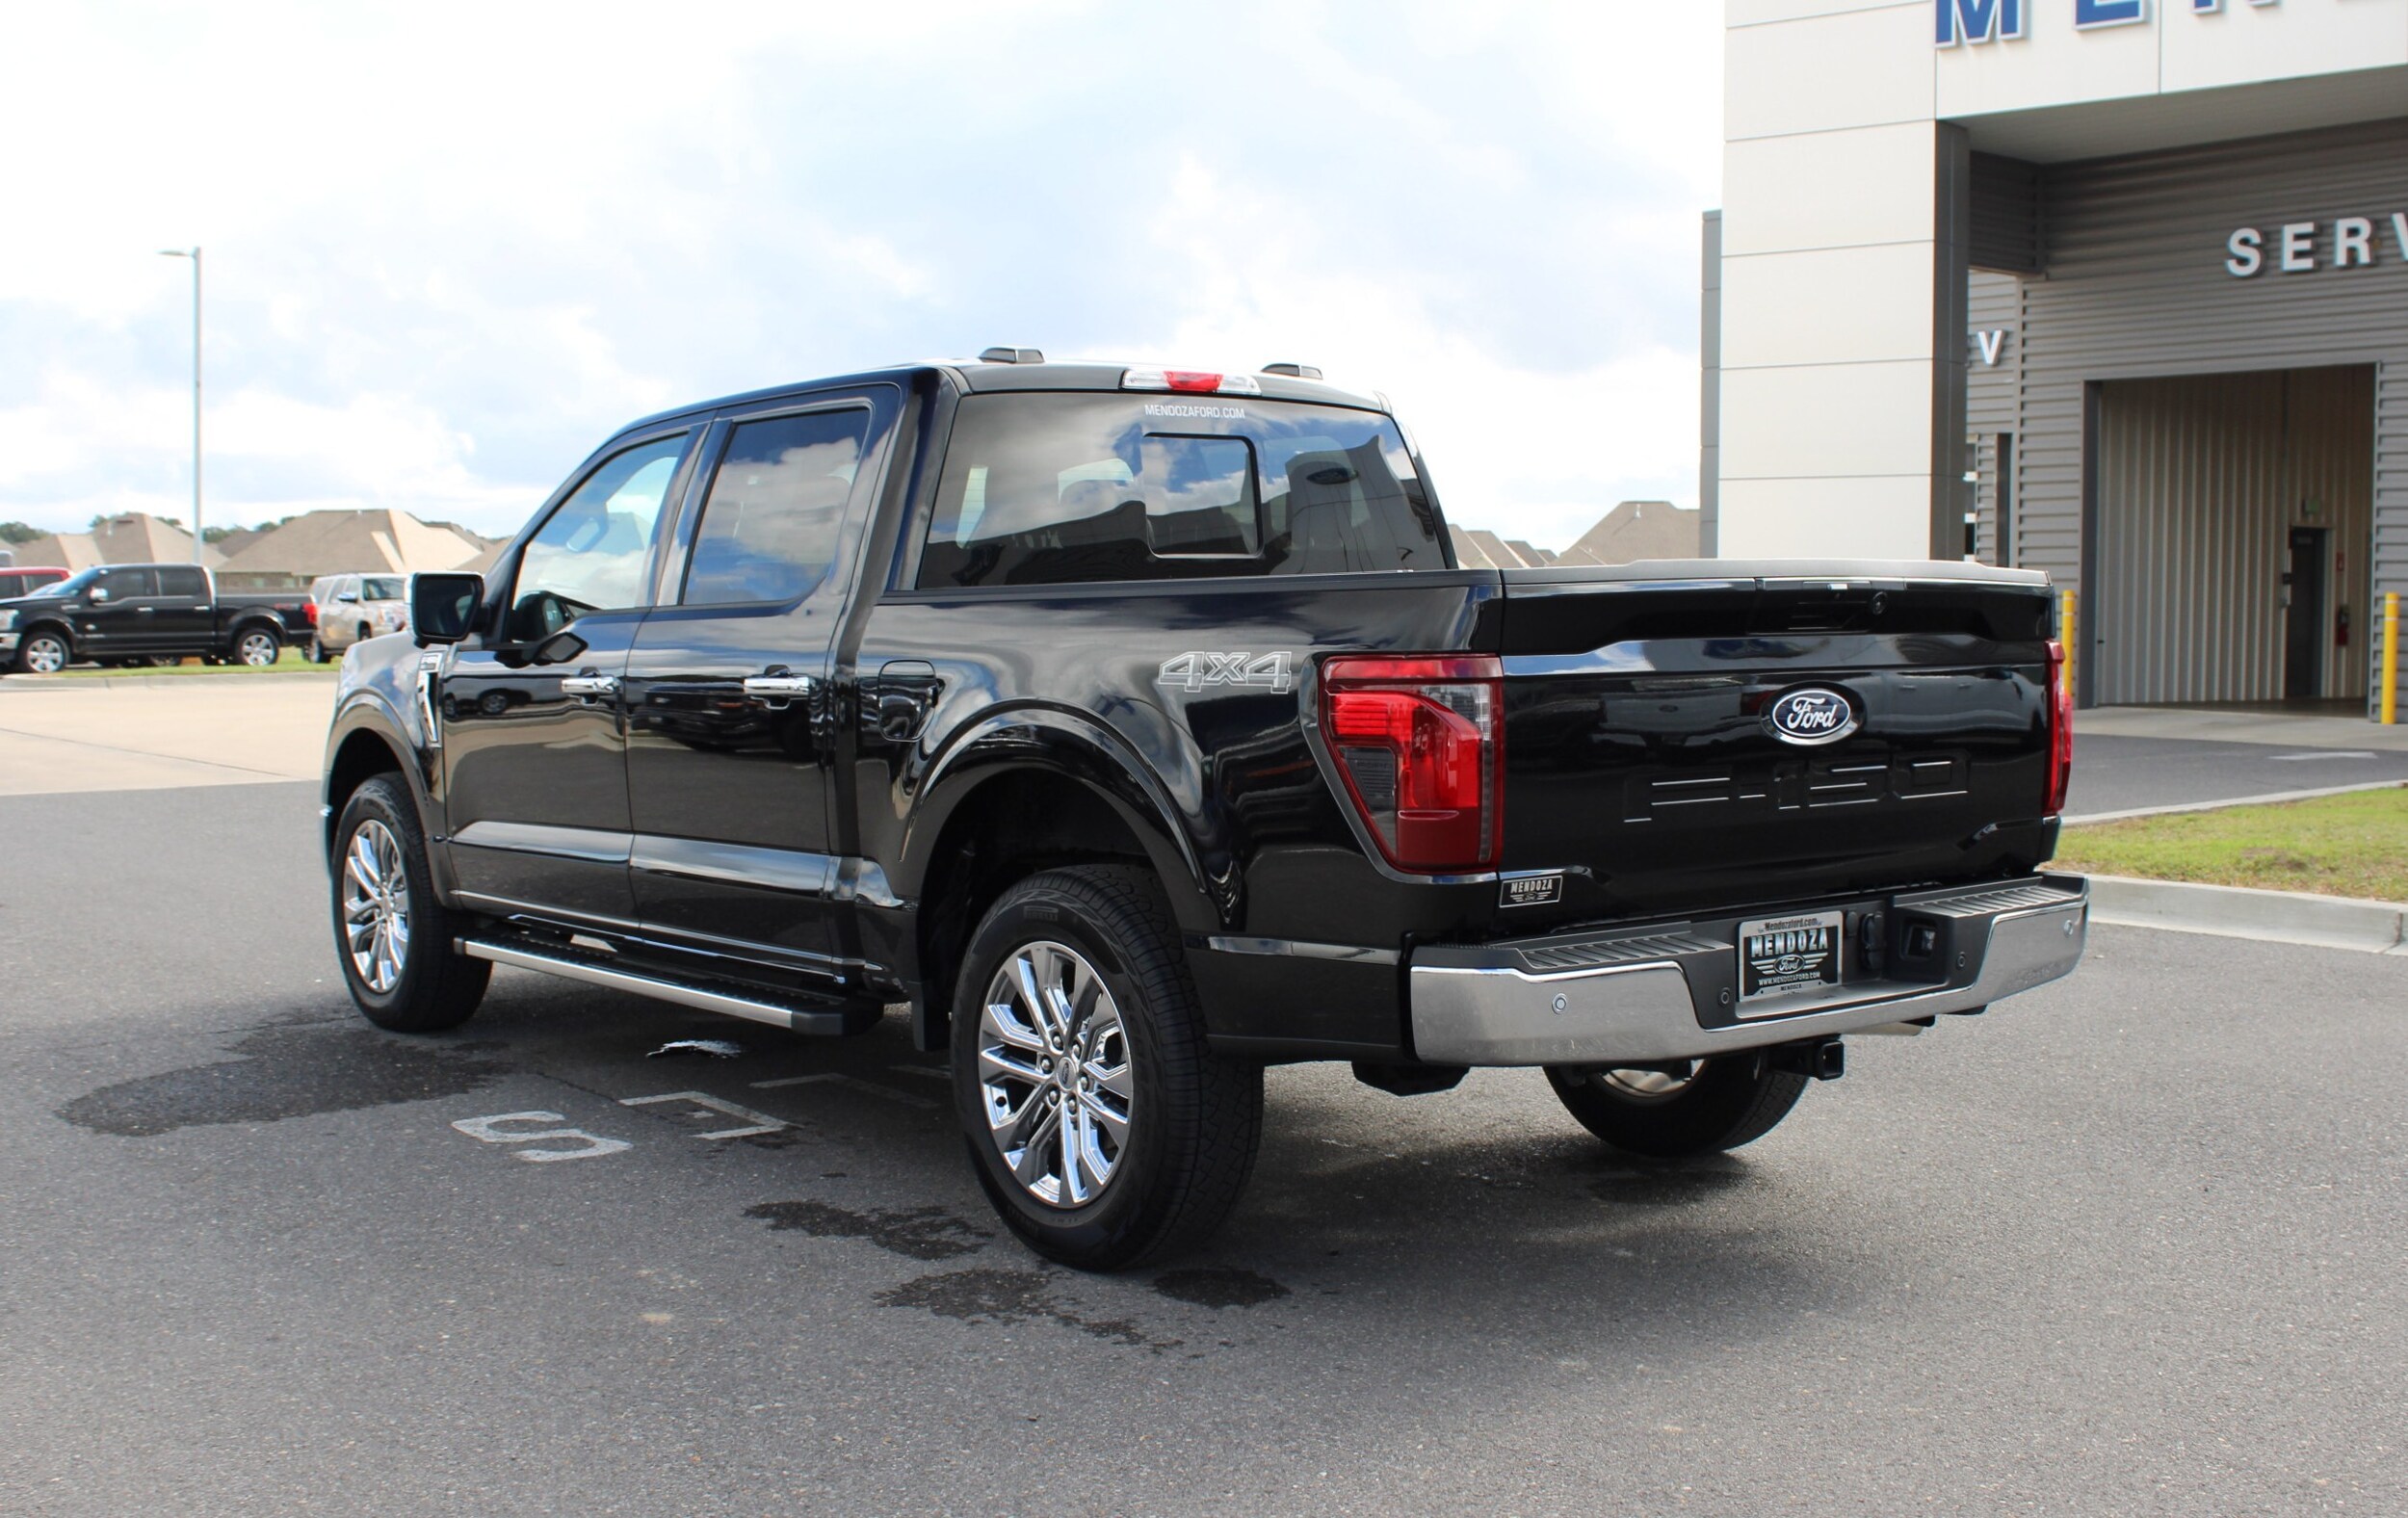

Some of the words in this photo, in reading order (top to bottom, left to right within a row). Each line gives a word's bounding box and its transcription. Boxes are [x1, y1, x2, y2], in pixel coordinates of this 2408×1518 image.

[1144, 405, 1246, 419] MENDOZAFORD.COM
[1786, 696, 1839, 730] Ford
[1623, 749, 1970, 824] F-150
[1510, 878, 1552, 893] MENDOZA
[1752, 929, 1828, 957] MENDOZA
[1779, 957, 1799, 971] Ford
